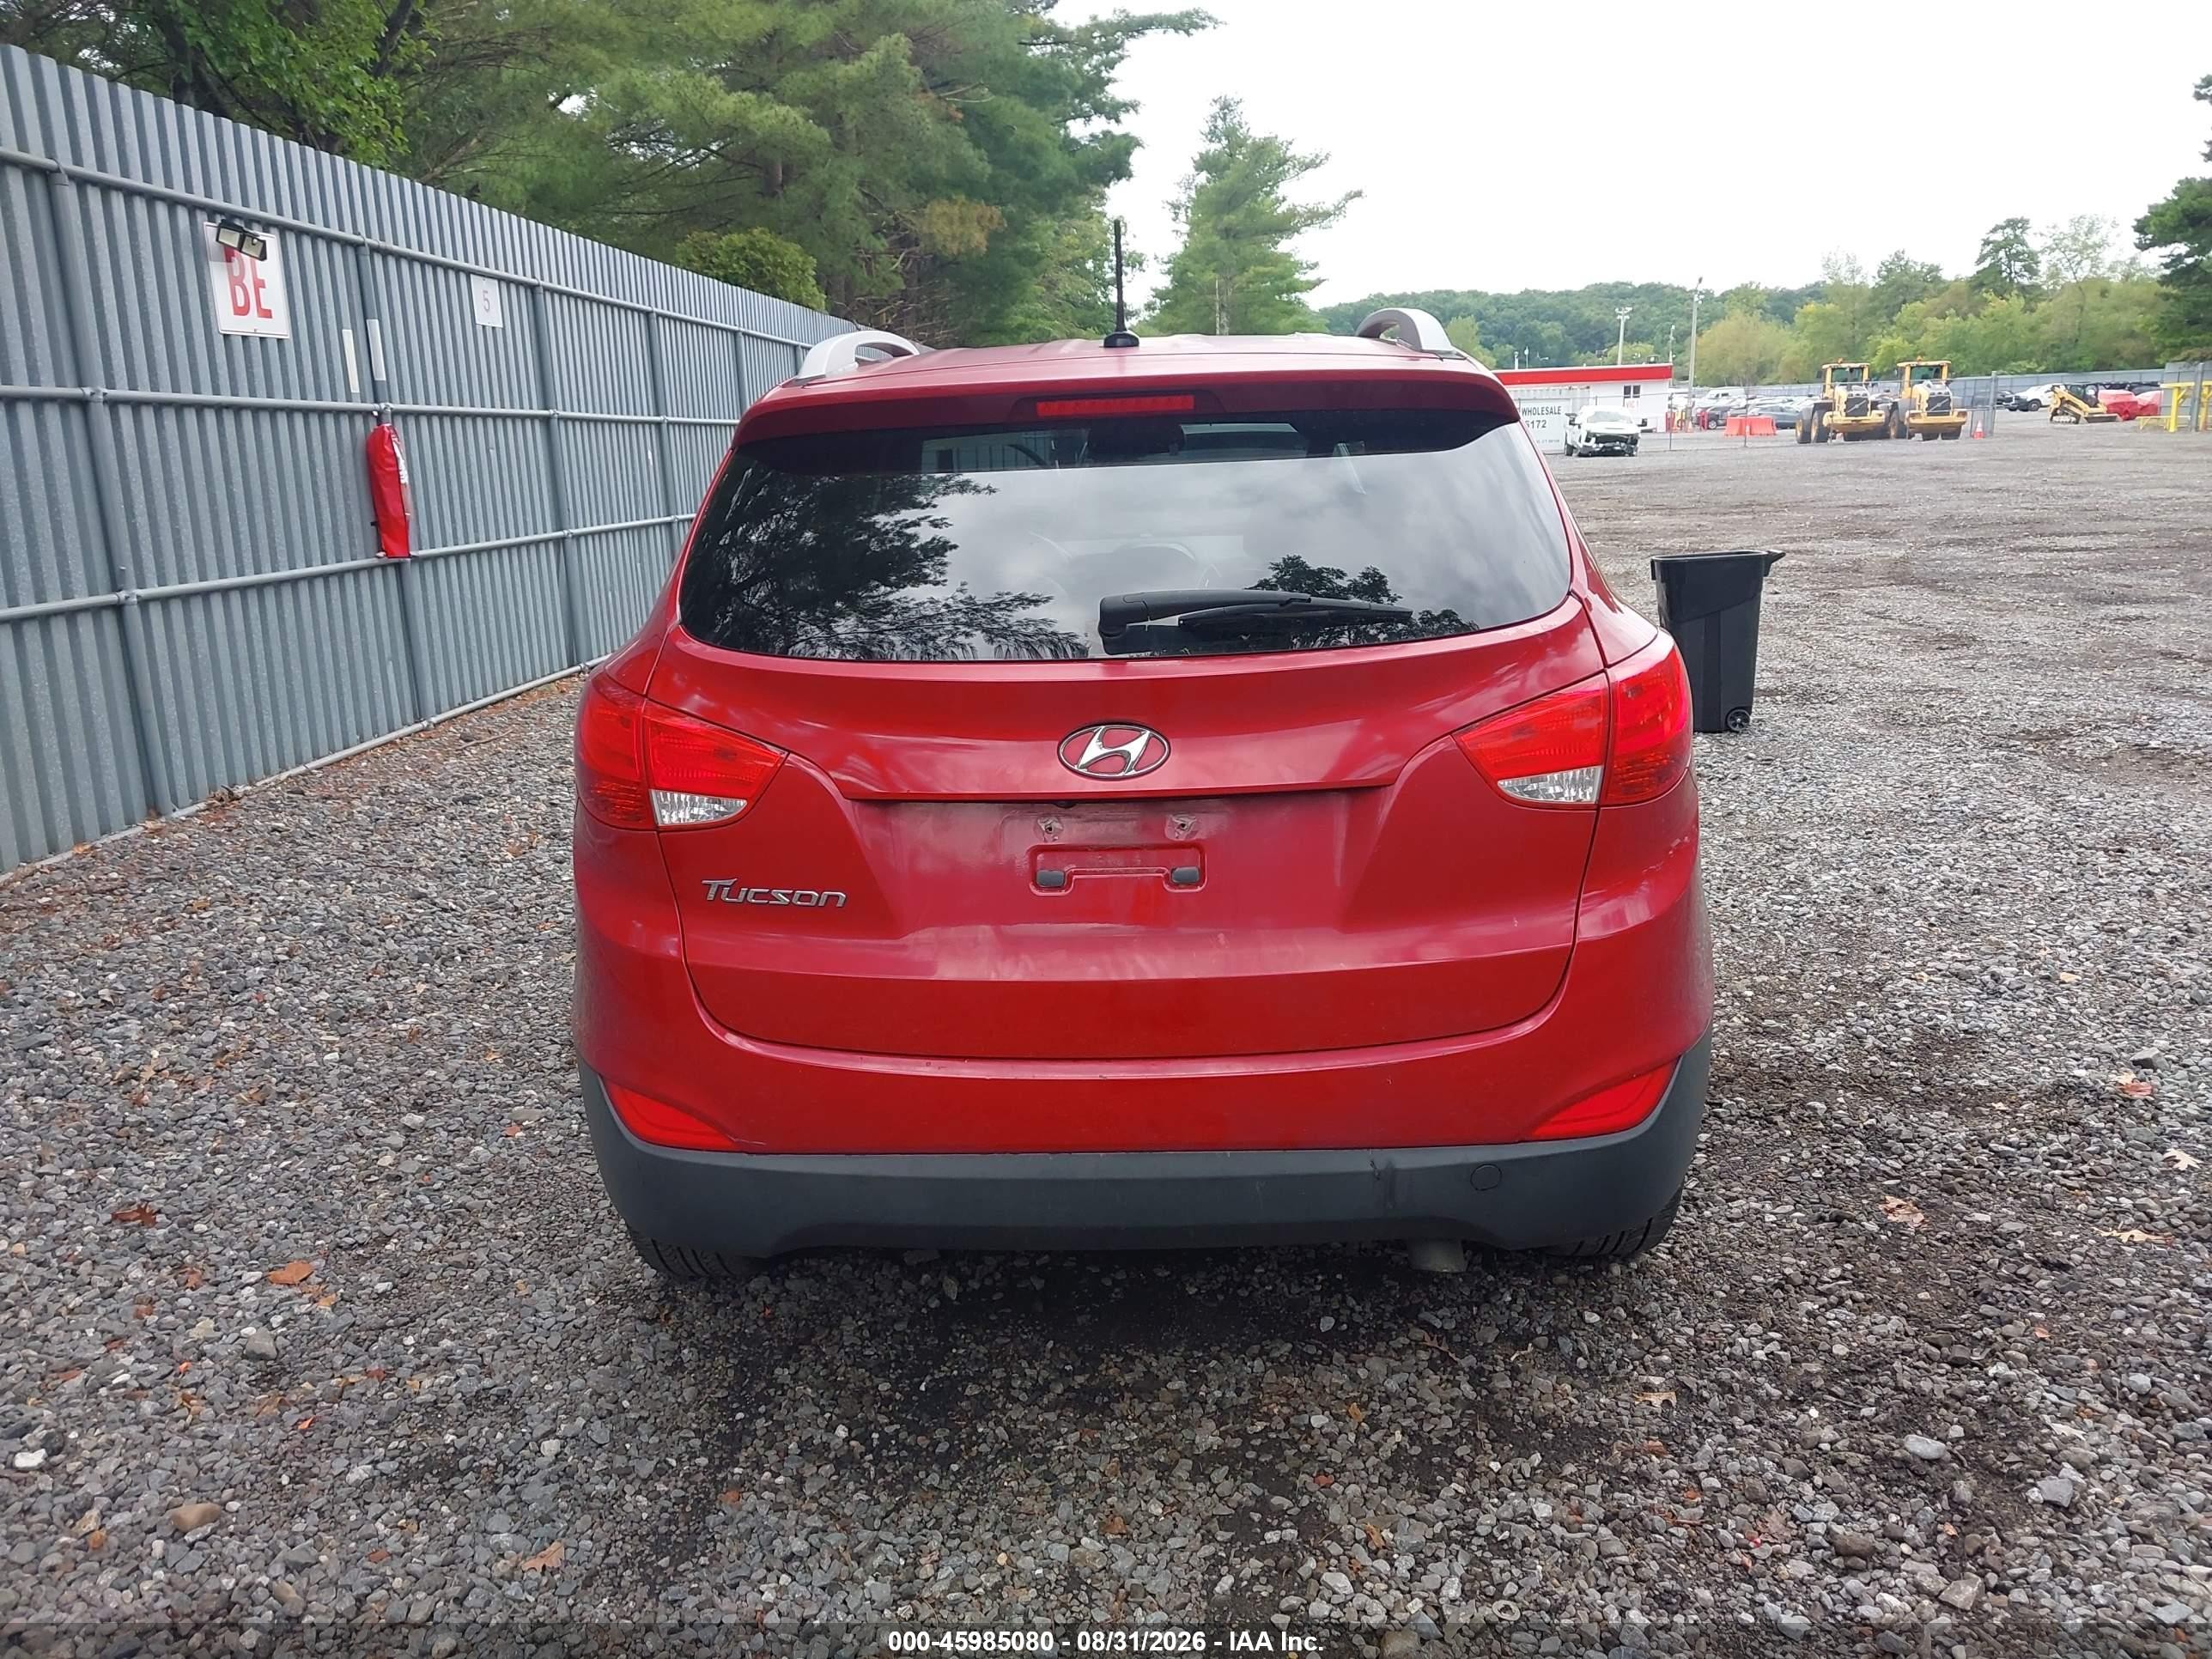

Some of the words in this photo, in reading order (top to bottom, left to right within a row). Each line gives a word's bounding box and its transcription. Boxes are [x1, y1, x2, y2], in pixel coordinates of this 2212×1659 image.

[482, 289, 490, 313] 5
[1522, 405, 1562, 416] WHOLESALE
[701, 878, 847, 908] Tucson
